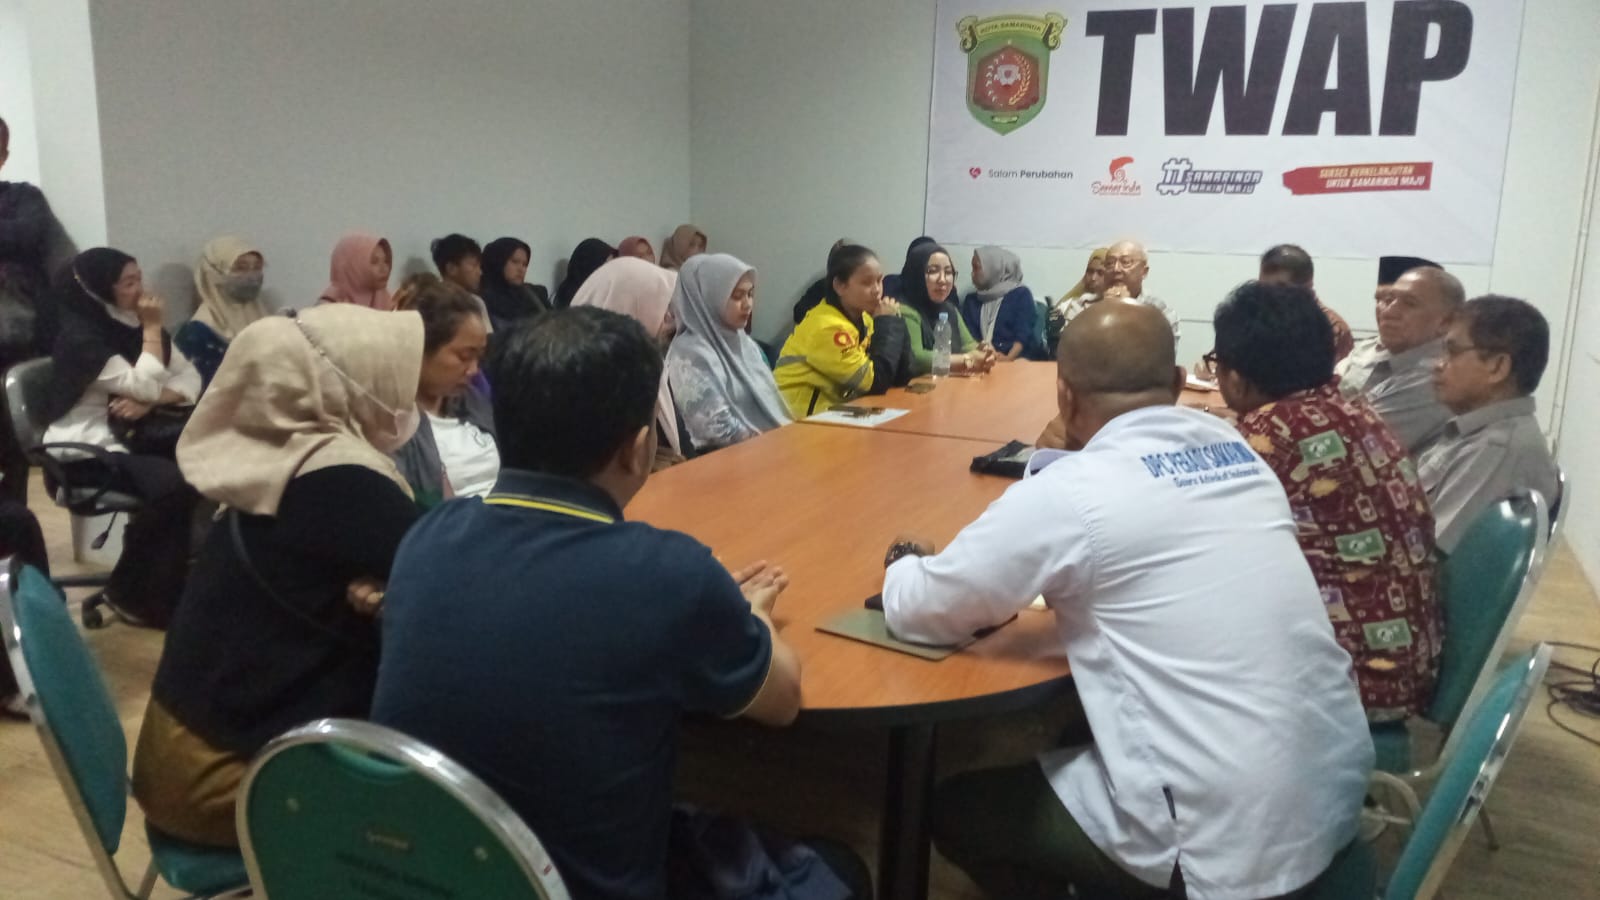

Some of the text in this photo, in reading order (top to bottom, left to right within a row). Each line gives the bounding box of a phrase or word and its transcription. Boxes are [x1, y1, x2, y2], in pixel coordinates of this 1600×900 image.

[1085, 0, 1473, 136] TWAP
[988, 169, 1074, 179] Salam Perubahan
[1319, 165, 1415, 178] SUKSES BERKELANJUTAN
[1325, 176, 1426, 188] UNTUK SAMARINDA MAJU
[1140, 453, 1175, 478] DPC
